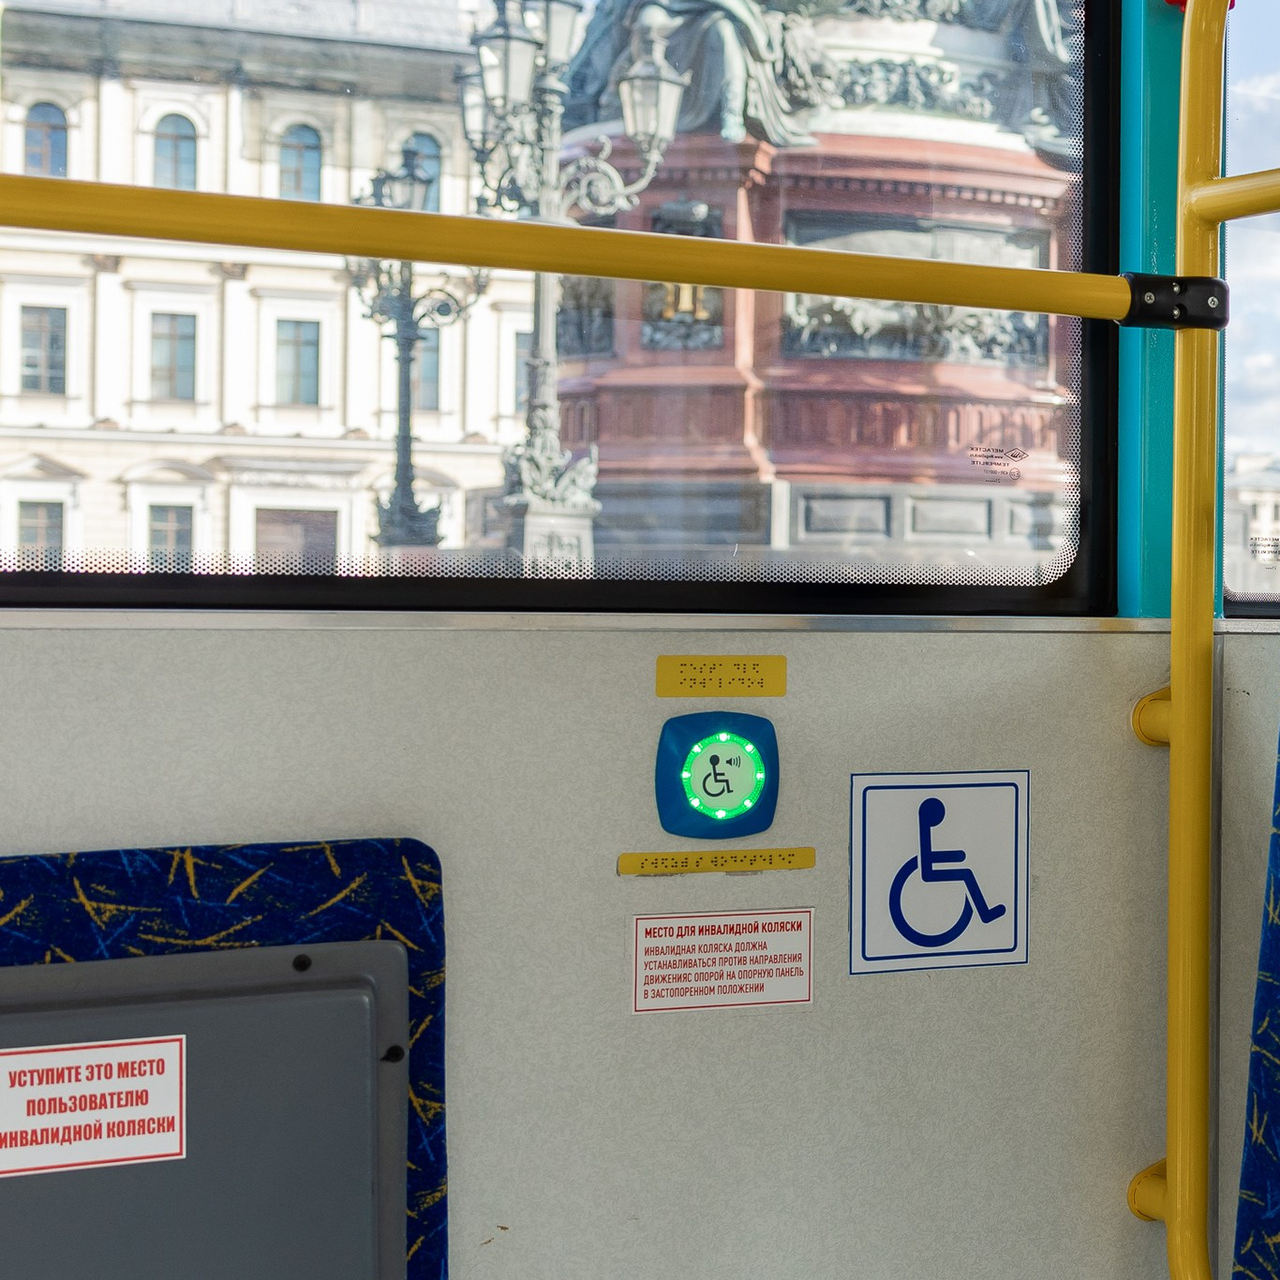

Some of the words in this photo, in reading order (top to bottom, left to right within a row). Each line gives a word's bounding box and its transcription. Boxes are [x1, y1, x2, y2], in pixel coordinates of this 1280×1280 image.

[644, 926, 674, 939] МЕСТО
[676, 926, 696, 939] ДЛЯ
[698, 921, 759, 937] ИНВАЛИДНОЙ
[761, 920, 803, 933] КОЛЯСКИ
[644, 944, 696, 957] ИНВАЛИДНАЯ
[698, 942, 733, 954] КОЛЯСКА
[734, 941, 768, 953] ДОЛЖНА
[643, 957, 717, 971] УСТАНАВЛИВАТЬСЯ
[718, 955, 748, 967] ПРОТИВ
[749, 953, 803, 965] НАПРАВЛЕНИЯ
[694, 969, 724, 982] ОПОРОЙ
[726, 970, 736, 980] НА
[738, 968, 773, 980] ОПОРНУЮ
[775, 966, 804, 977] ПАНЕЛЬ
[643, 989, 649, 999] В
[650, 986, 716, 999] ЗАСТОПОРЕННОМ
[717, 983, 765, 996] ПОЛОЖЕНИИ
[8, 1065, 82, 1088] УСТУПИТЕ
[85, 1062, 113, 1081] ЭТО
[117, 1058, 165, 1079] МЕСТО
[26, 1089, 149, 1117] ПОЛЬЗОВАТЕЛЮ
[0, 1119, 102, 1149] ИНВАЛИДНОЙ
[106, 1116, 175, 1139] КОЛЯСКИ
